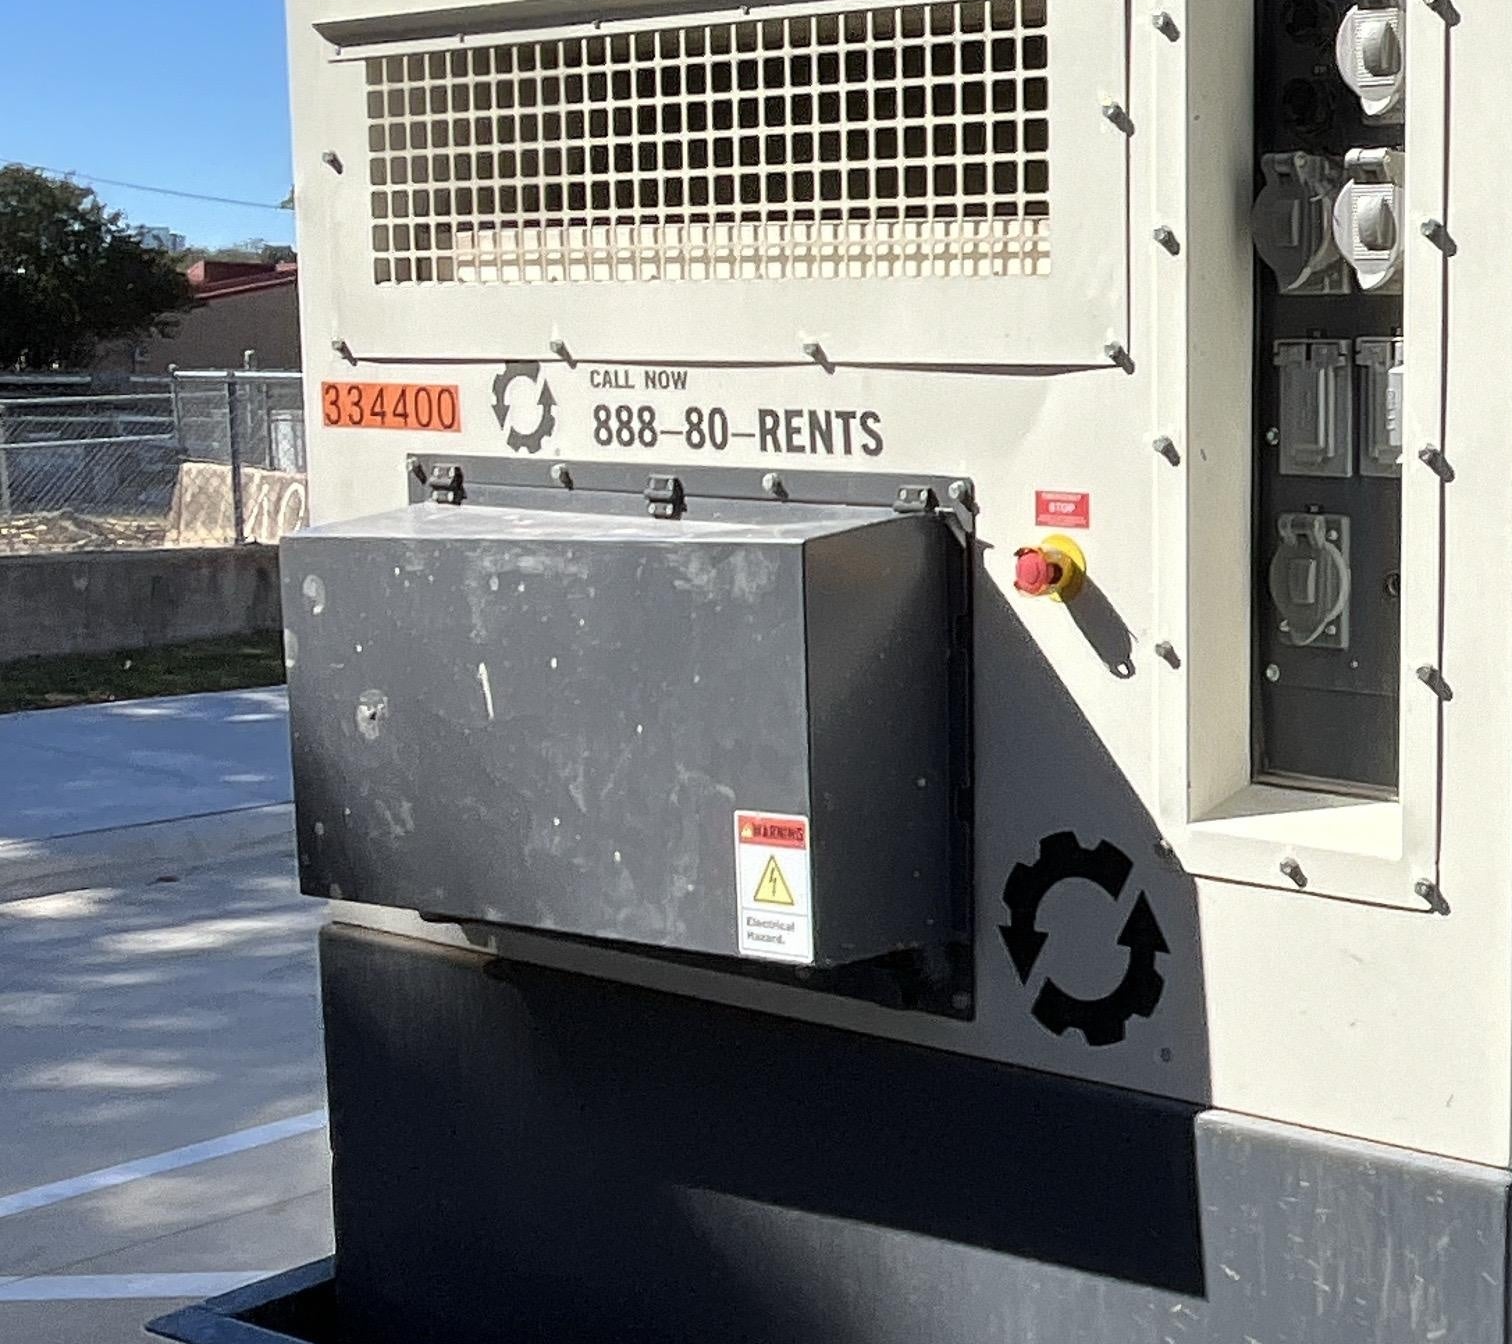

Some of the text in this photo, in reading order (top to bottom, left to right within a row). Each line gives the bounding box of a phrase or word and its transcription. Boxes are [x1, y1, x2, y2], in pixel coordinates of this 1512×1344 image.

[589, 370, 689, 391] CALL NOW
[324, 383, 457, 431] 334400
[592, 404, 885, 457] 888-80-RENTS
[752, 822, 805, 842] WARNING
[746, 916, 796, 933] Electrical
